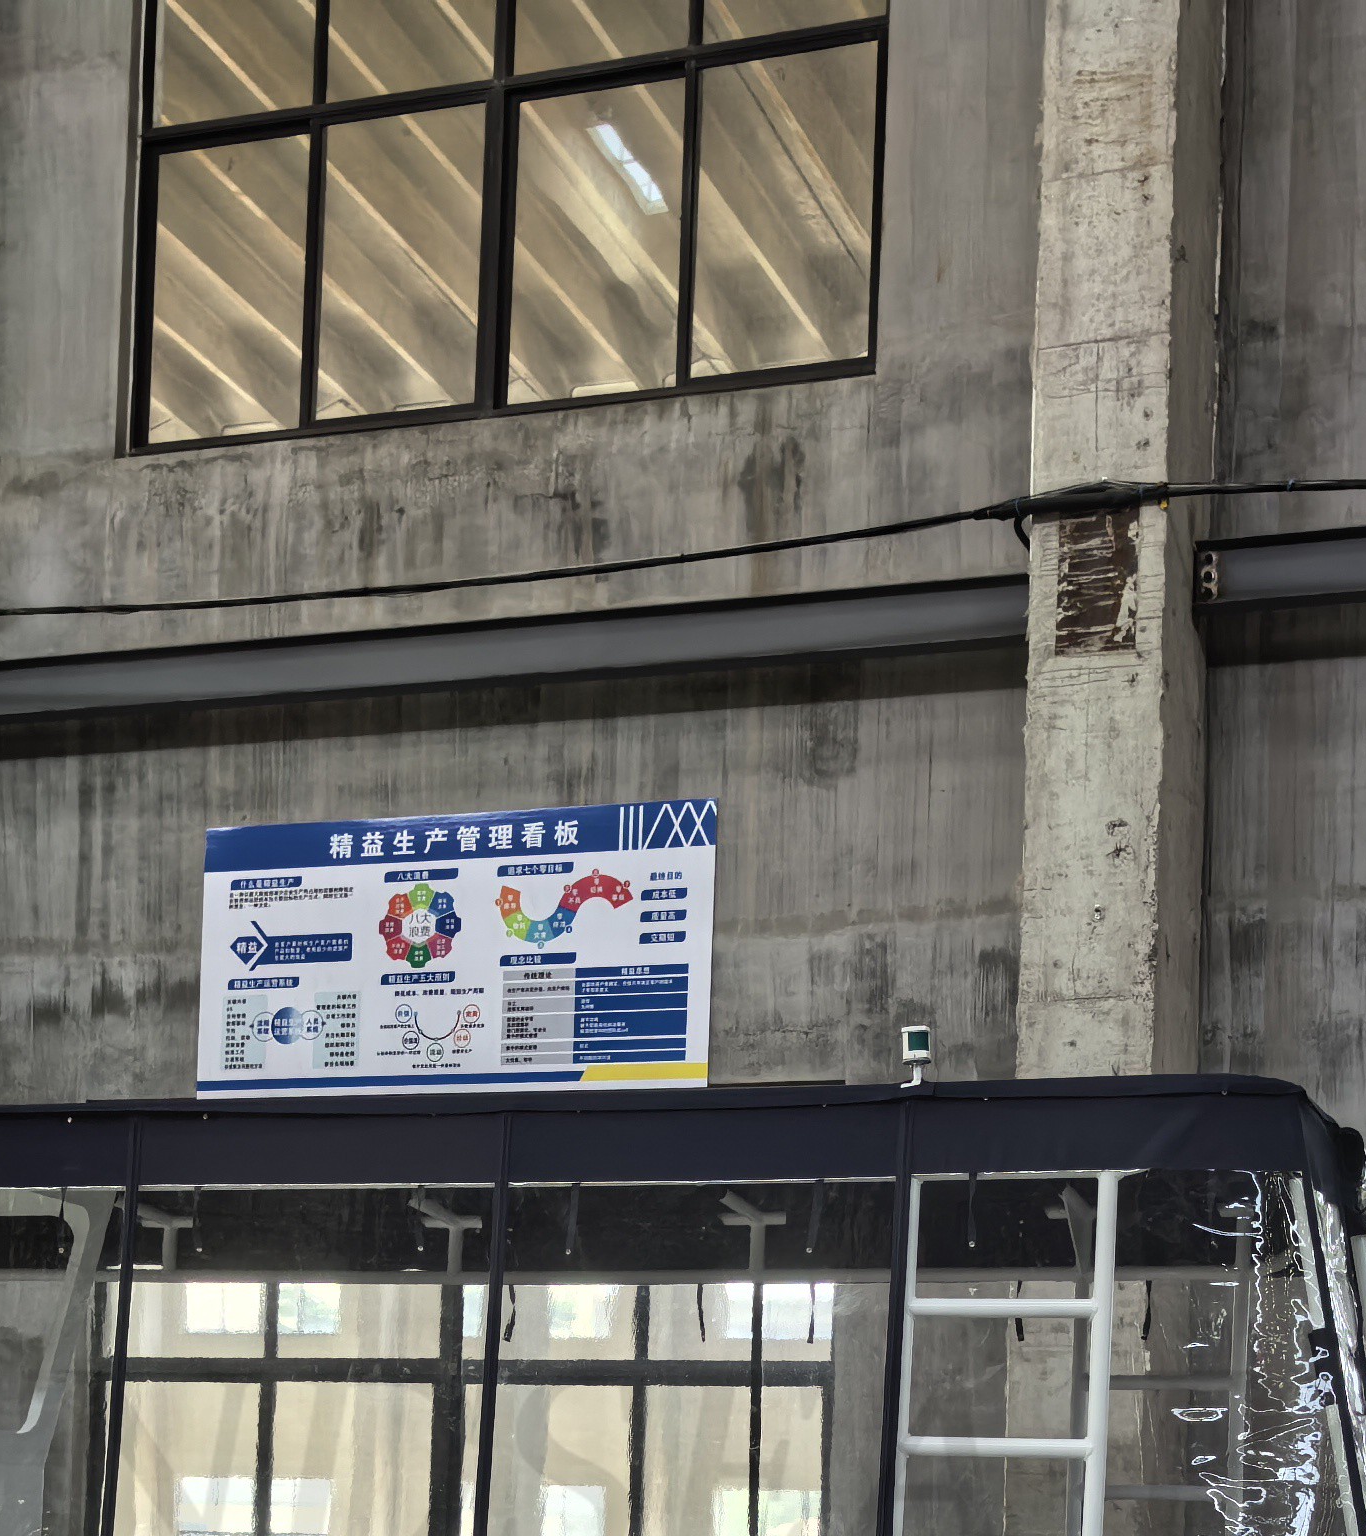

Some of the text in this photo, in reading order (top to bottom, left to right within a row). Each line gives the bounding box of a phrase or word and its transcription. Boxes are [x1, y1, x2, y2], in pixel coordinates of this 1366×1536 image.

[329, 820, 579, 859] 精益生产管理看板
[236, 941, 258, 954] 精益
